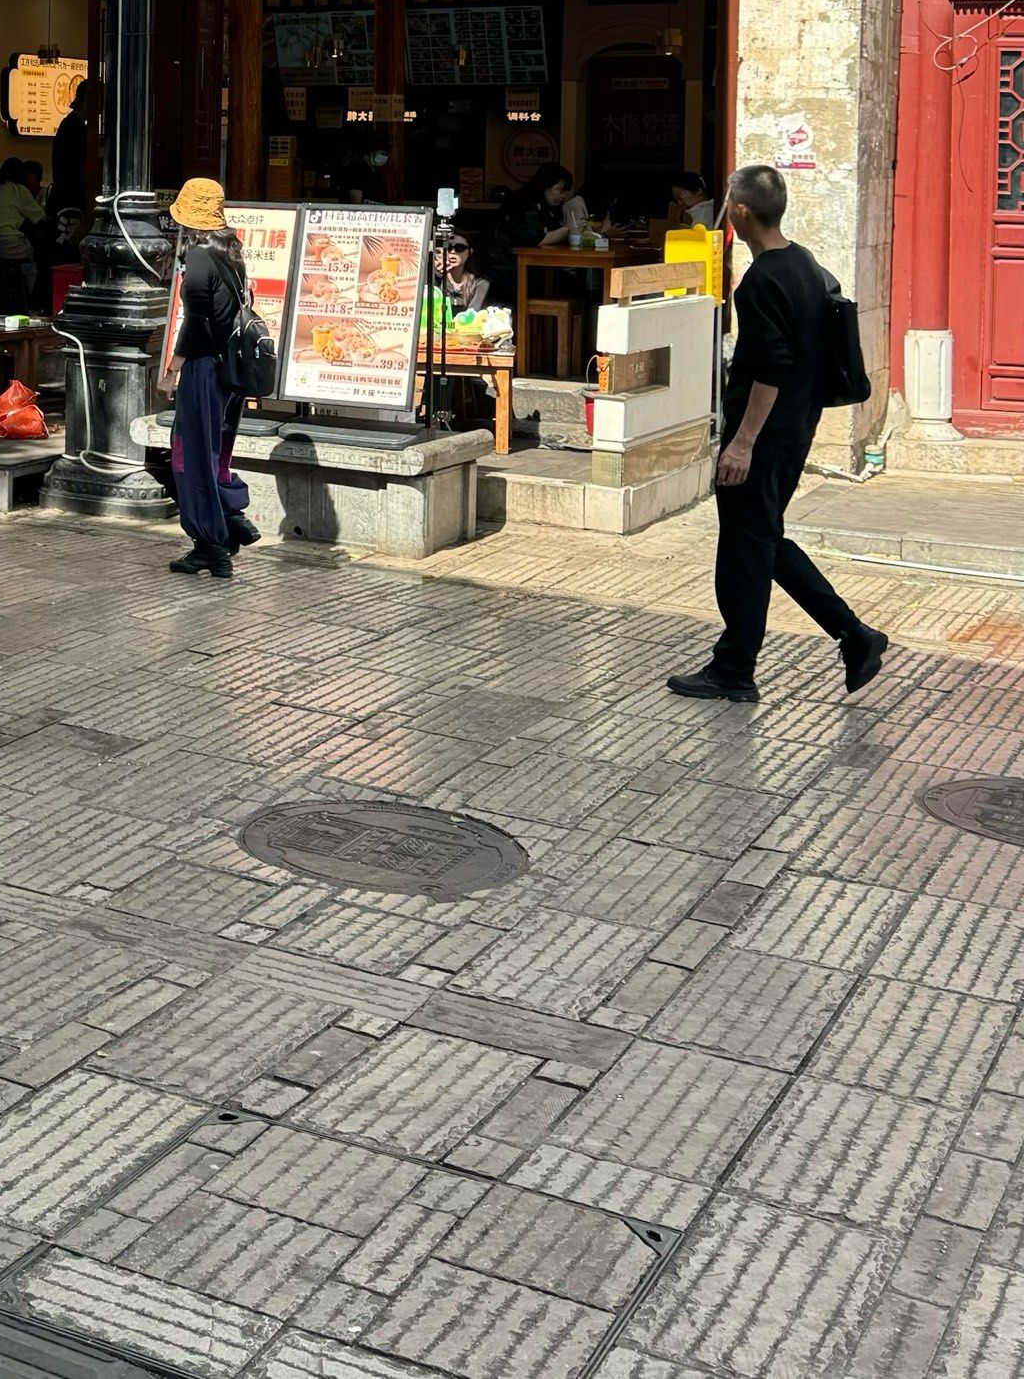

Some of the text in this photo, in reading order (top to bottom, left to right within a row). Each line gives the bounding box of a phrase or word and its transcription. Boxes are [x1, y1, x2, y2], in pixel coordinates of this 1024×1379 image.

[327, 262, 351, 273] 15.9
[386, 305, 409, 317] 19.9
[380, 358, 404, 371] 39.9
